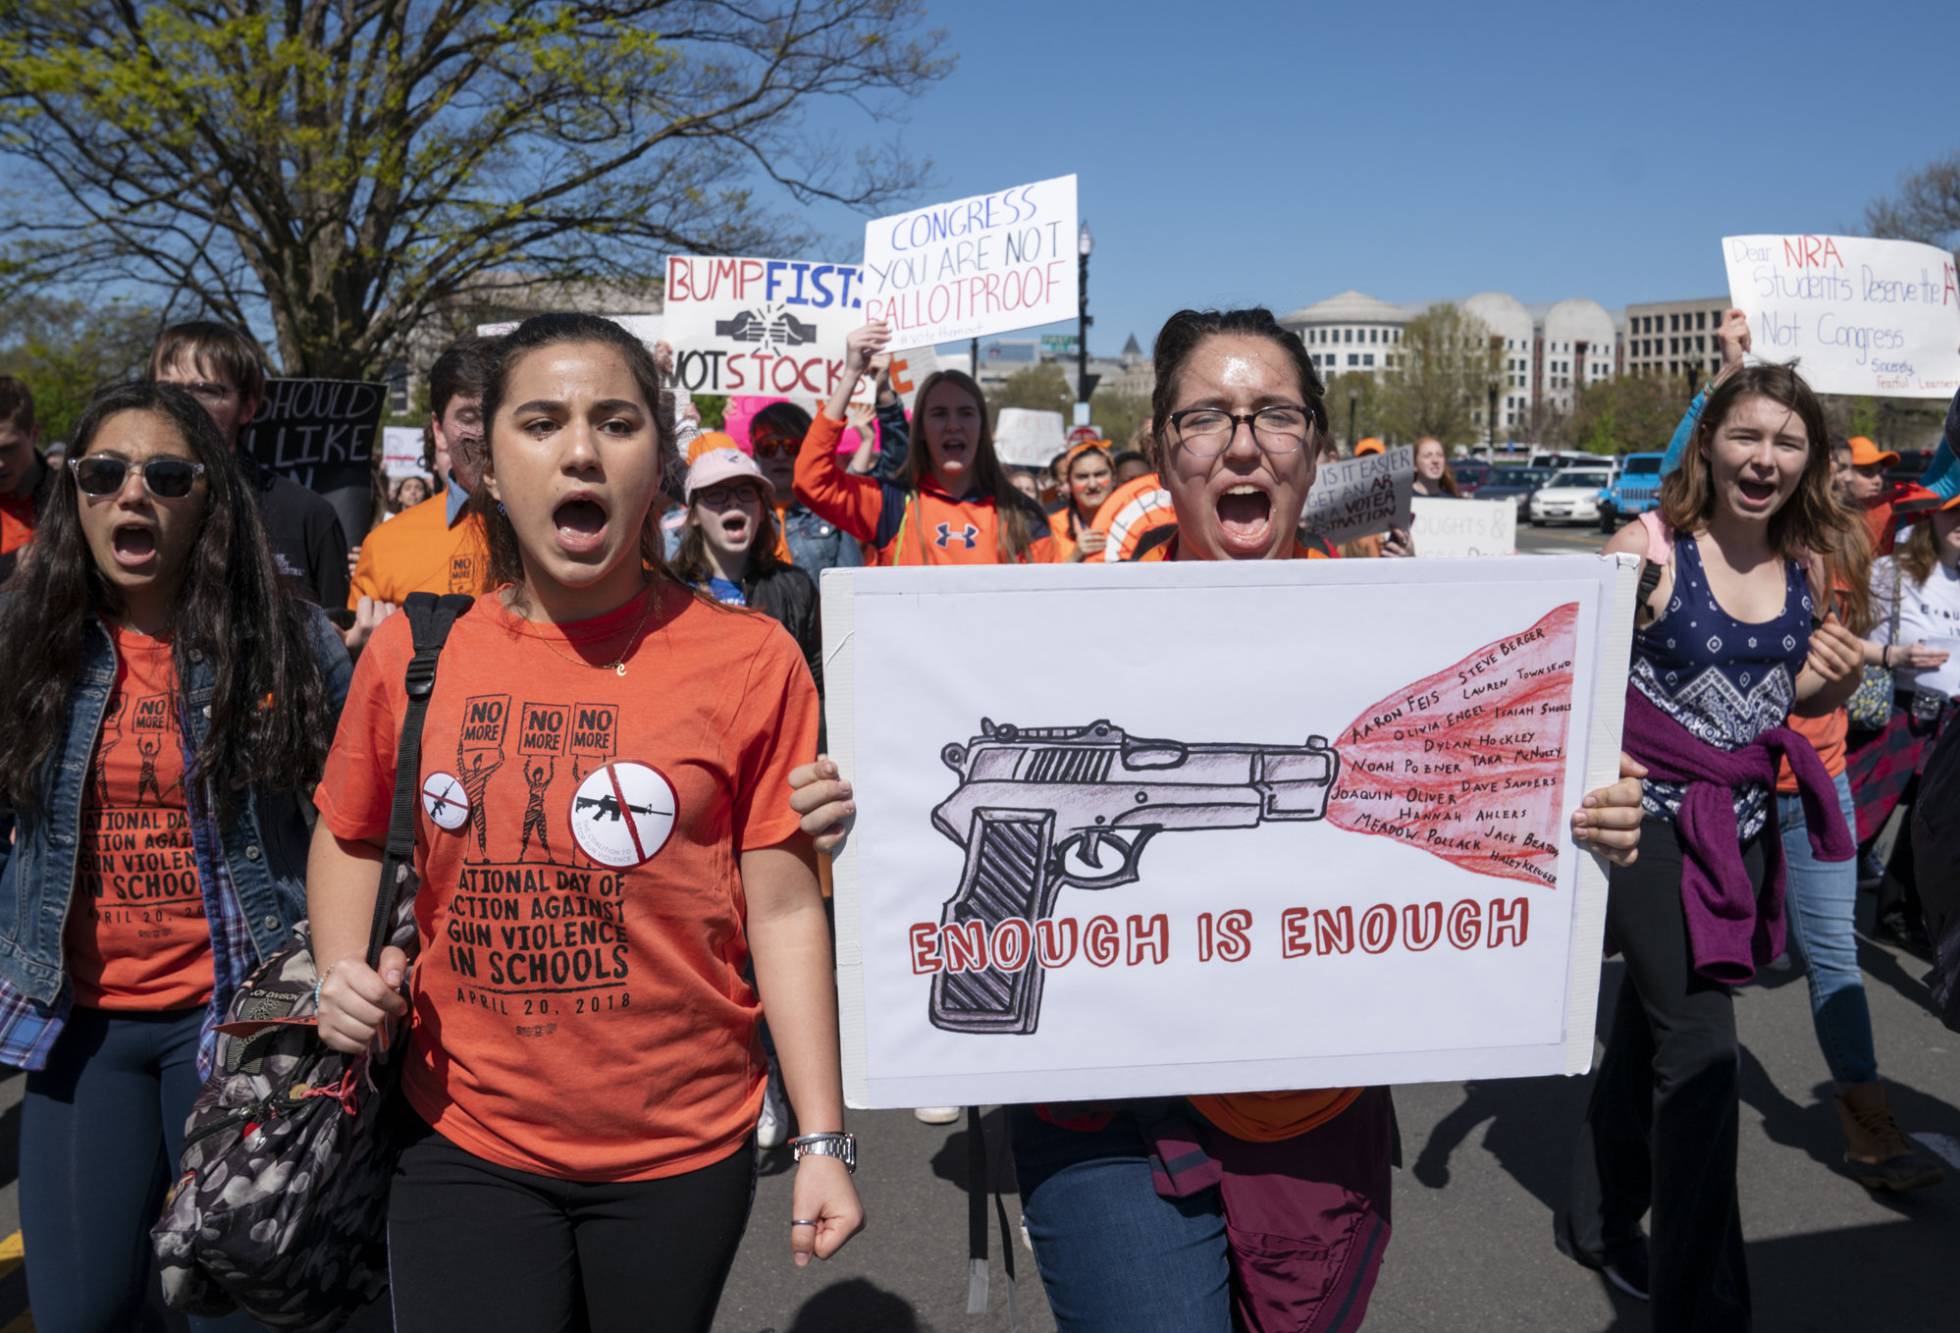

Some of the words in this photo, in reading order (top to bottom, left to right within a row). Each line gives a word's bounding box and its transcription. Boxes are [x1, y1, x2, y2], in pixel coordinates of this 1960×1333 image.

[891, 186, 1037, 251] CONGRESS
[869, 254, 927, 294] YOU
[937, 235, 992, 281] ARE
[1005, 220, 1062, 266] NOT
[1732, 239, 1771, 263] Dear
[1783, 235, 1844, 268] NRA
[1753, 265, 1852, 303] Students
[1862, 264, 1918, 304] Deserve
[1762, 311, 1801, 347] Not
[1817, 312, 1904, 366] Congress
[274, 424, 372, 468] LIKE
[1322, 468, 1338, 487] IS
[1342, 463, 1355, 482] IT
[1360, 449, 1411, 479] EASIER
[1370, 473, 1393, 494] AR
[1344, 491, 1396, 515] VOTER
[452, 557, 472, 569] NO
[1458, 653, 1498, 685] STEVE
[1499, 627, 1546, 656] BERGER
[1463, 678, 1508, 700] LAUREN
[139, 700, 166, 716] NO
[470, 701, 503, 724] NO
[1352, 708, 1402, 744] AARON
[1406, 690, 1440, 712] FEIS
[1494, 705, 1534, 719] ISAIAH
[136, 715, 165, 729] MORE
[528, 709, 563, 732] NO
[577, 709, 613, 731] NO
[1393, 721, 1440, 741] OLIVIA
[1446, 705, 1486, 727] ENGEL
[464, 724, 500, 742] MORE
[523, 733, 561, 751] MORE
[573, 731, 610, 749] MORE
[1424, 739, 1472, 753] DYLAN
[1480, 732, 1535, 746] HOCKLEY
[1351, 758, 1394, 772] NOAH
[1471, 754, 1502, 767] TARA
[1330, 785, 1393, 800] JOAQUIN
[1406, 787, 1457, 805] OLIVER
[1462, 780, 1498, 793] DAVE
[1503, 777, 1557, 790] SANDERS
[167, 812, 192, 829] DA
[1400, 807, 1461, 822] HANNAH
[1475, 809, 1527, 822] AHLERS
[1353, 812, 1419, 840] MEADOW
[1427, 828, 1481, 851] POLLACK
[1484, 825, 1517, 844] JACK
[556, 869, 592, 894] DAY
[599, 873, 626, 897] OF
[531, 895, 626, 924] AGAINST
[447, 918, 493, 948] GUN
[501, 920, 630, 951] VIOLENCE
[909, 912, 1171, 976] ENOUGH
[1197, 909, 1253, 963] IS
[1281, 896, 1530, 960] ENOUGH
[448, 945, 478, 978] IN
[488, 944, 630, 985] SCHOOLS
[457, 987, 509, 1016] APRIL
[576, 992, 631, 1014] 2018
